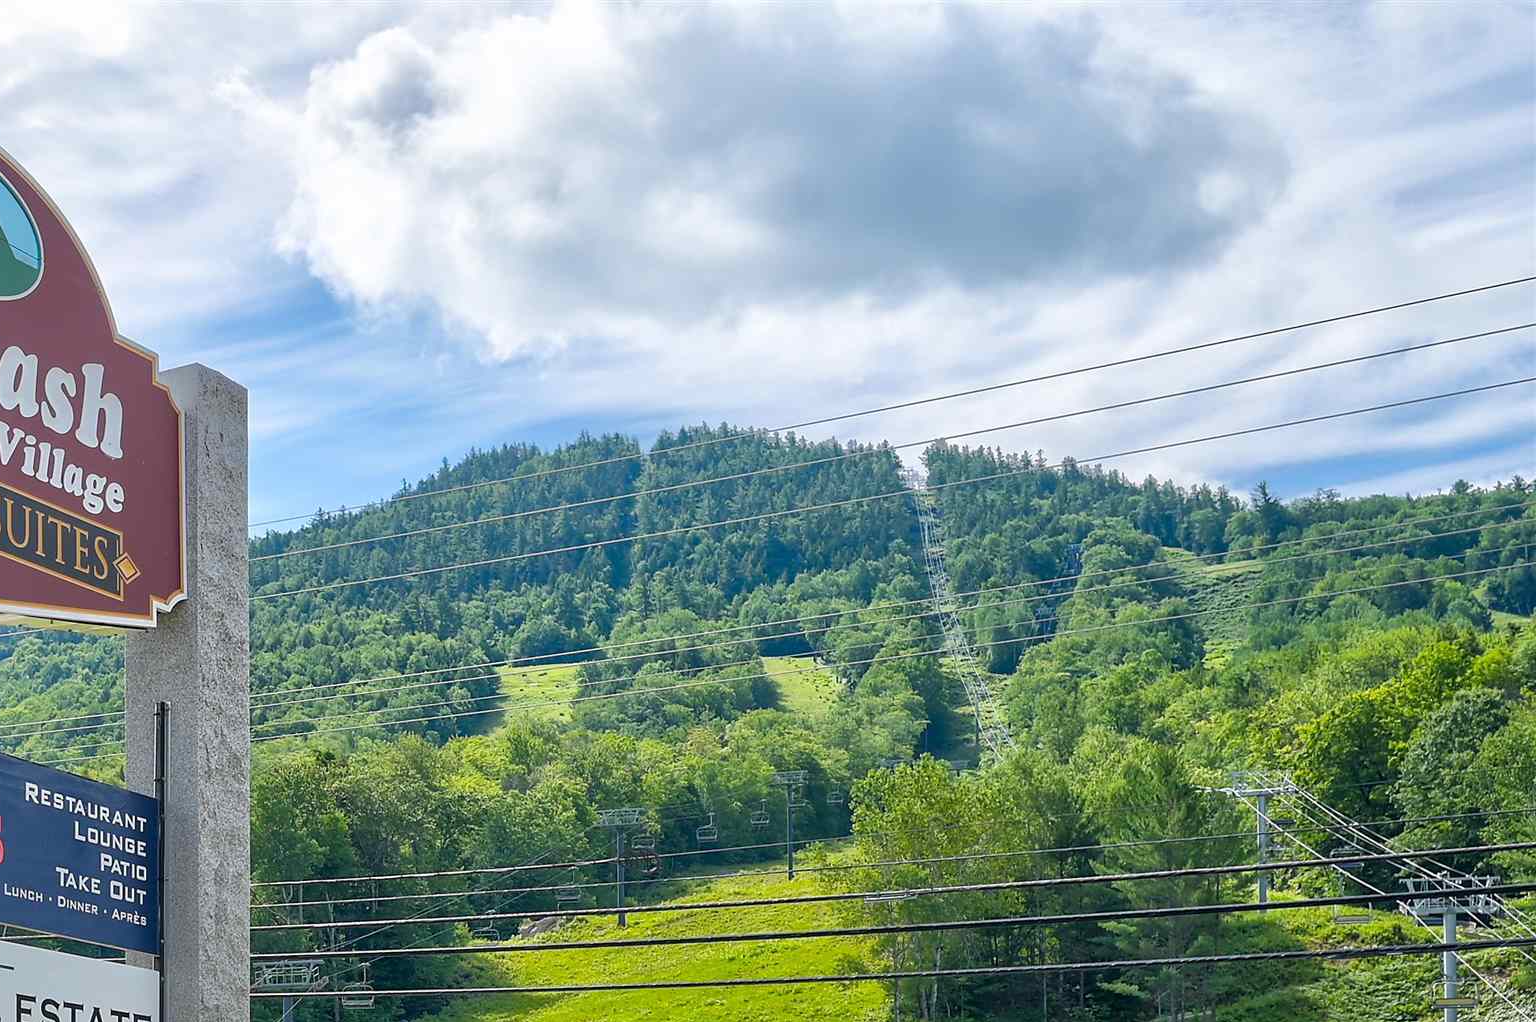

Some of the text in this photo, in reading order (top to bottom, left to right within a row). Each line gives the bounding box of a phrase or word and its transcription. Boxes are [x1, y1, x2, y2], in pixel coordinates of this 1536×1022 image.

[24, 781, 147, 834] RESTAURANT
[73, 820, 147, 857] LOUNGE
[55, 866, 147, 906] TAKE OUT
[100, 853, 147, 882] PATIO
[3, 883, 43, 903] LUNCH
[57, 895, 98, 915] DINNER
